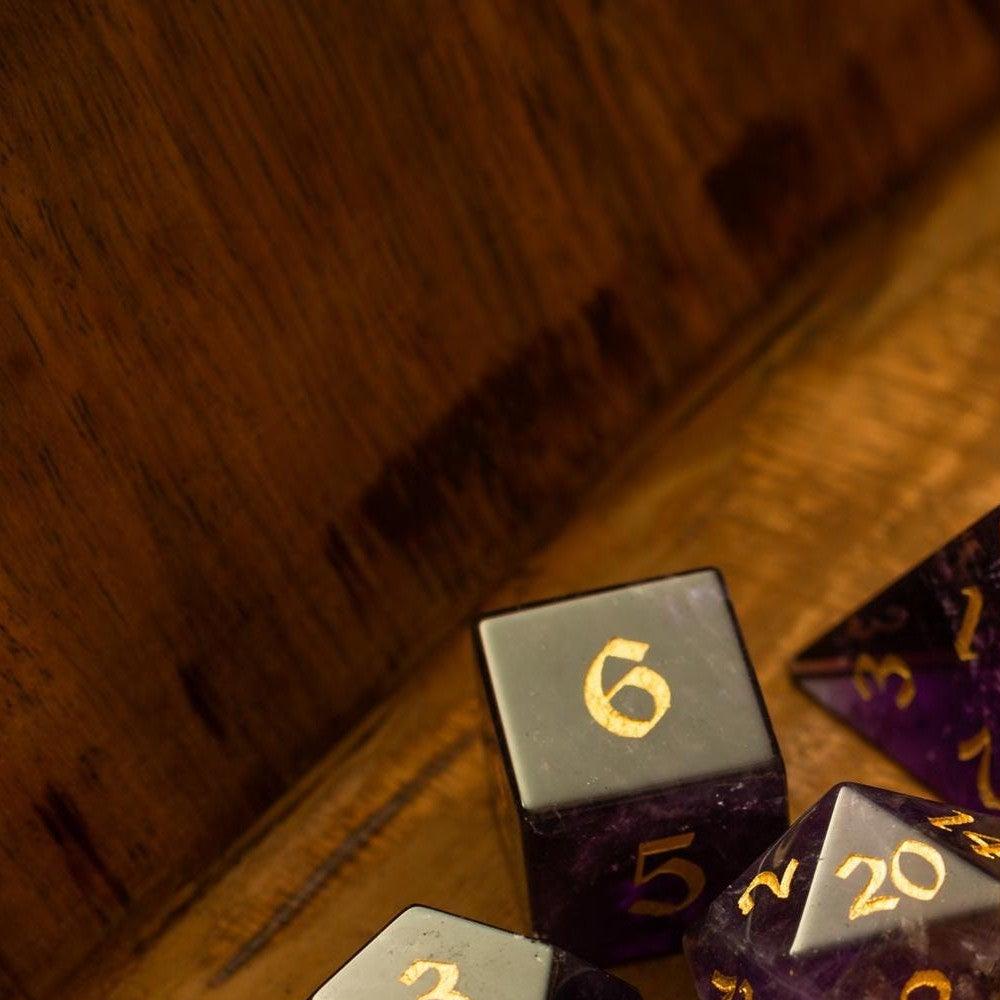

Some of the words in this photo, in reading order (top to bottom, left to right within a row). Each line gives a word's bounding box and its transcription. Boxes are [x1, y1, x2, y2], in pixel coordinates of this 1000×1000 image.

[953, 584, 984, 662] 1
[583, 637, 672, 739] 6
[628, 832, 706, 916] 5
[738, 858, 799, 915] 2
[835, 839, 946, 920] 20
